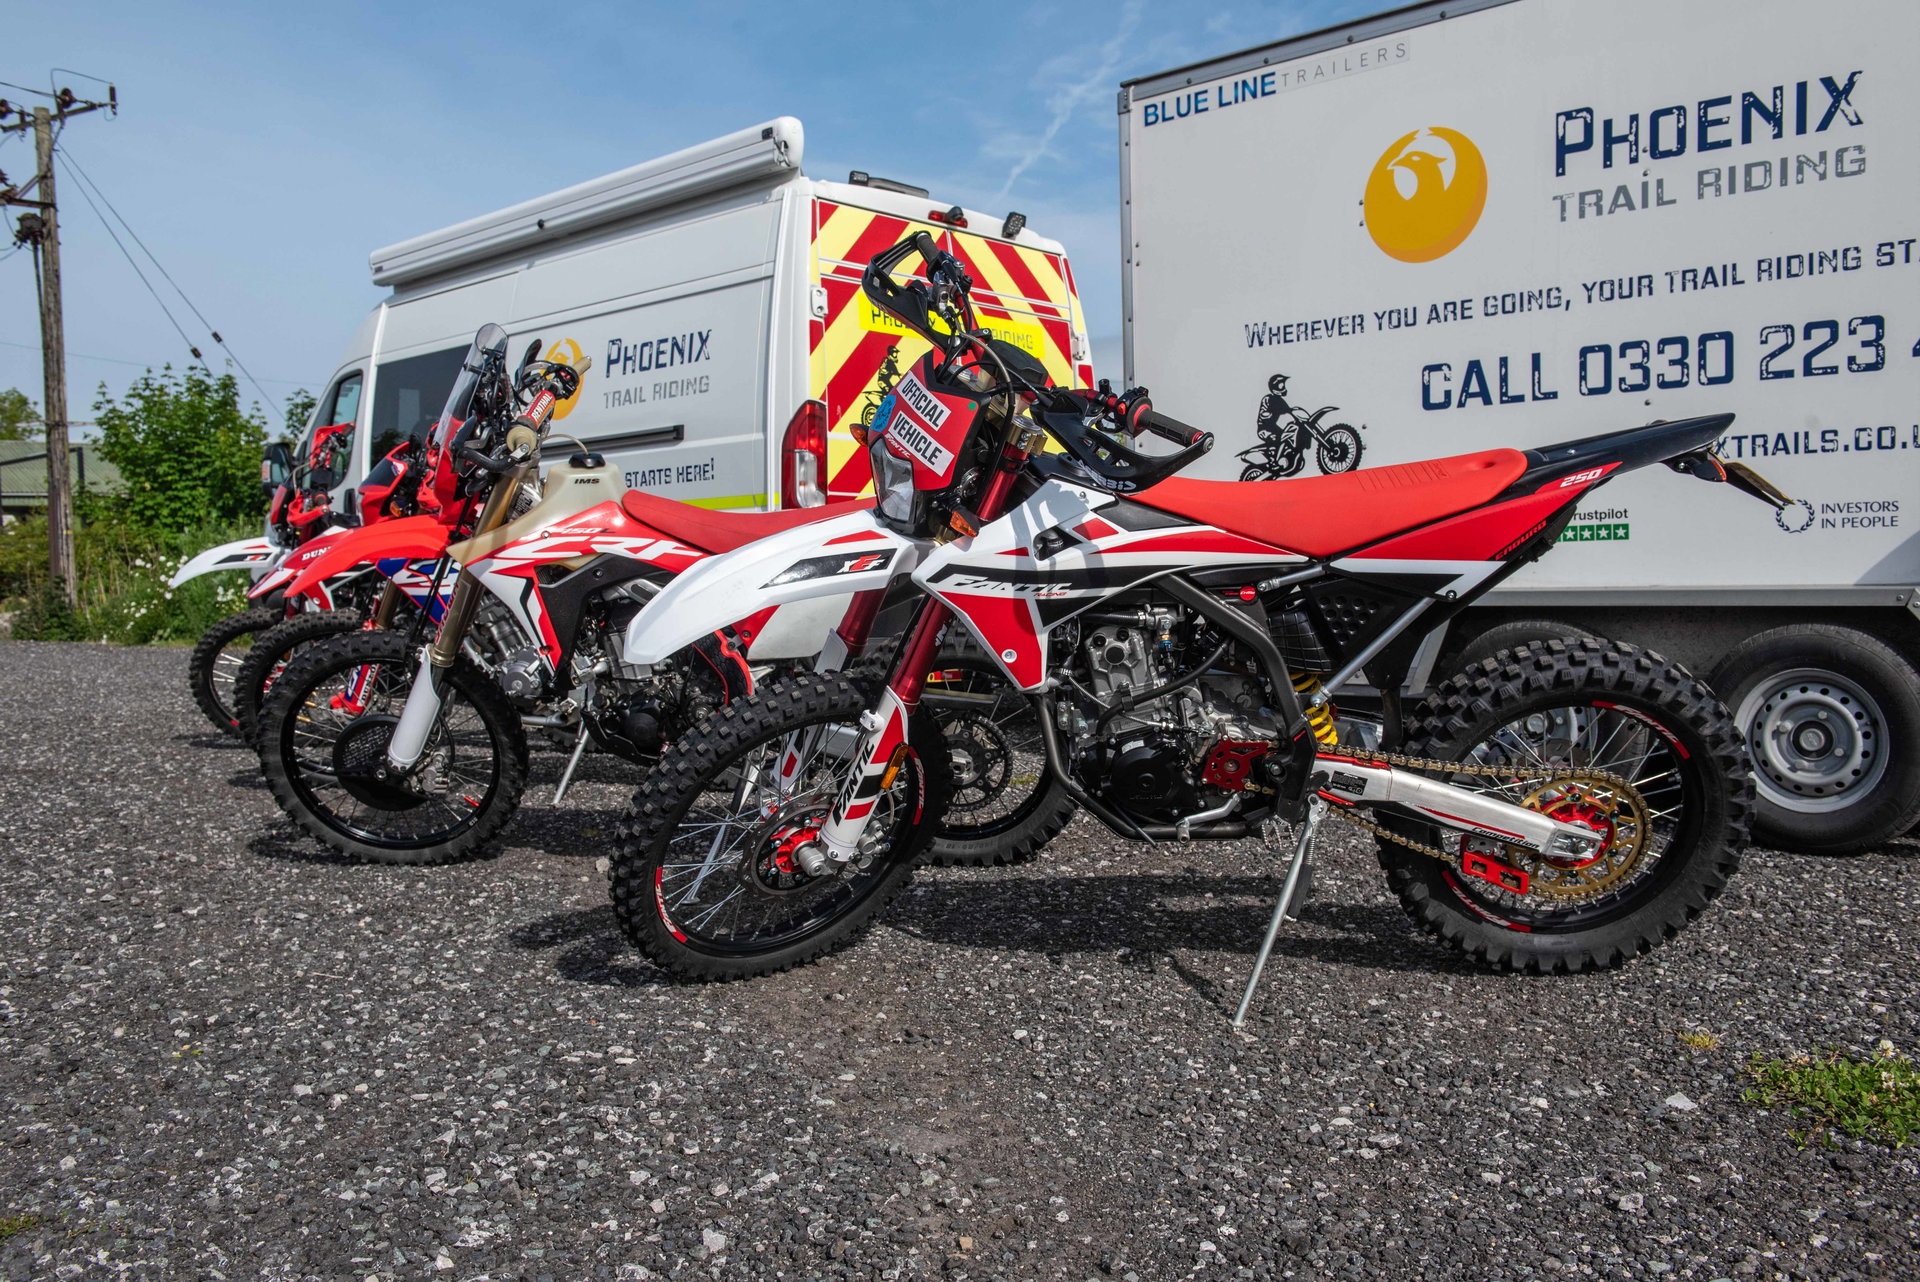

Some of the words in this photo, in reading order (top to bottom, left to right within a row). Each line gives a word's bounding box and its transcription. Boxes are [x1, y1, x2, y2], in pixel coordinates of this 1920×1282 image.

[1143, 91, 1209, 127] BLUE
[1217, 71, 1276, 108] LINE
[1281, 42, 1408, 88] TRAILERS
[1552, 178, 1676, 223] TRAIL
[1696, 145, 1868, 201] RIDING
[1374, 307, 1418, 331] YOU
[1426, 301, 1474, 325] ARE
[1483, 286, 1572, 317] GOING,
[1581, 275, 1655, 304] YOUR
[1664, 262, 1745, 295] TRAIL
[1756, 246, 1863, 283] RIDING
[1876, 238, 1920, 267] ST
[1421, 351, 1559, 412] CALL
[1578, 330, 1735, 397] 0330
[1759, 314, 1886, 381] 223
[531, 393, 554, 423] RENTHAL
[603, 388, 647, 409] TRAIL
[652, 375, 711, 401] RIDING
[901, 379, 942, 428] OFFICIAL
[885, 432, 911, 459] FANTIC
[892, 413, 944, 467] VEHICLE
[574, 478, 601, 486] IMS
[624, 467, 673, 489] STARTS
[676, 457, 716, 484] HERE!
[1560, 468, 1604, 488] 250
[1573, 507, 1629, 522] rustpilot
[1821, 501, 1900, 514] INVESTORS
[1821, 517, 1836, 529] IN
[1841, 515, 1899, 528] PEOPLE
[301, 545, 332, 561] DUN
[494, 535, 703, 559] CRF
[936, 573, 1073, 592] FANTIC
[1616, 705, 1679, 744] FANTIC
[833, 742, 874, 827] FANTIC
[913, 757, 925, 809] FANTIC
[1471, 826, 1541, 849] Competition
[655, 883, 678, 933] FANTIC
